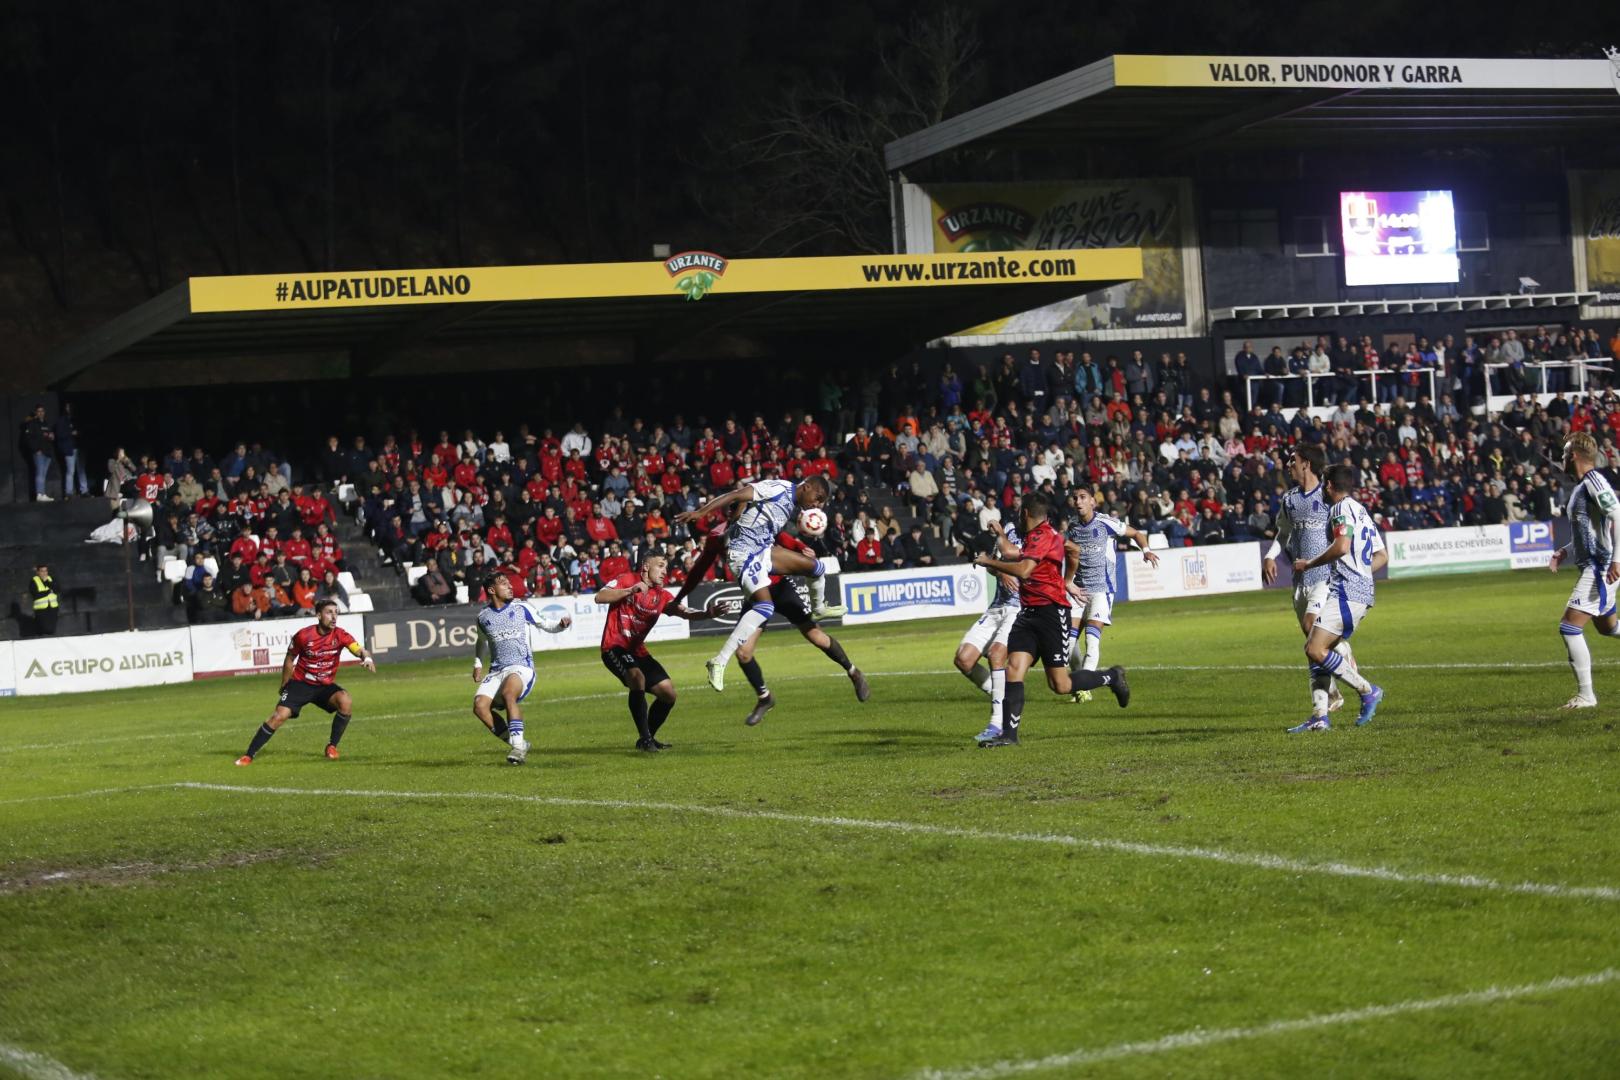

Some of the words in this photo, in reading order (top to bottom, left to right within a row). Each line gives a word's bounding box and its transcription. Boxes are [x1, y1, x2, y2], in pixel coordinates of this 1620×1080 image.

[1209, 63, 1276, 84] VALOR,
[1281, 64, 1380, 83] PUNDONOR
[1383, 64, 1396, 83] Y
[1402, 65, 1463, 83] GARRA
[943, 207, 1026, 233] URZANTE
[669, 254, 723, 272] URZANTE
[862, 256, 1076, 282] www.urzante.com
[276, 274, 471, 302] #AUPATUDELANO
[1513, 523, 1549, 545] JP
[747, 561, 762, 577] 30
[851, 586, 877, 612] IT
[878, 580, 951, 603] IMPOTUSA
[574, 601, 596, 615] La
[51, 657, 114, 676] GRUPO
[119, 651, 184, 670] AISMAR
